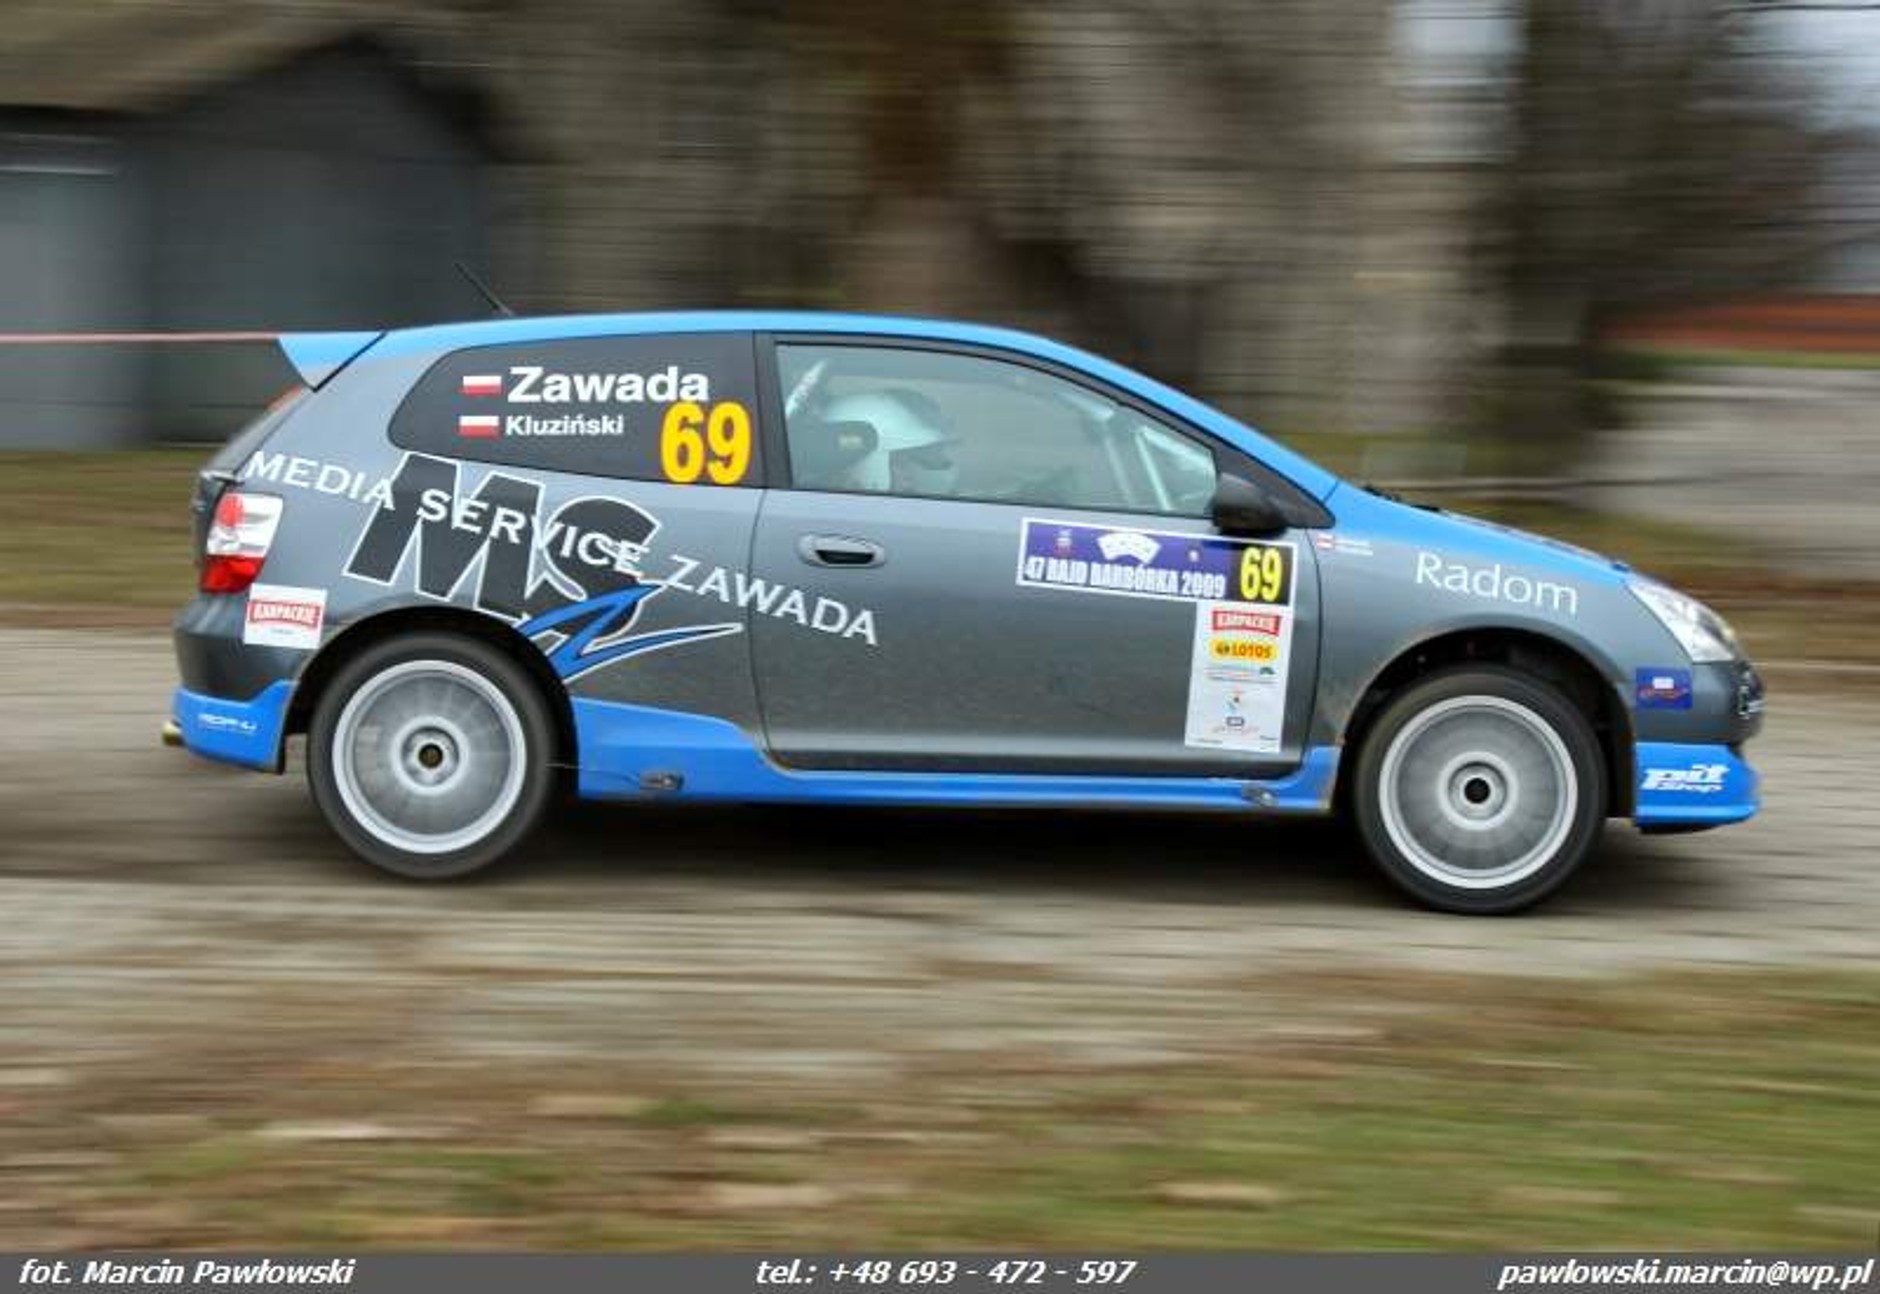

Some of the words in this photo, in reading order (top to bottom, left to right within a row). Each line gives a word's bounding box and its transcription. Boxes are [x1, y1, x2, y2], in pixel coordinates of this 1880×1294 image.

[508, 366, 710, 402] Zawada
[505, 413, 624, 436] Kluziński
[661, 400, 752, 485] 69
[246, 451, 396, 511] MEDIA
[416, 488, 650, 577] SERVICE
[665, 554, 879, 647] ZAWADA
[1240, 546, 1284, 601] 69
[1025, 556, 1047, 582] 47
[1182, 573, 1227, 599] 2009
[1416, 551, 1579, 617] Radom
[1231, 643, 1273, 659] LOTOS
